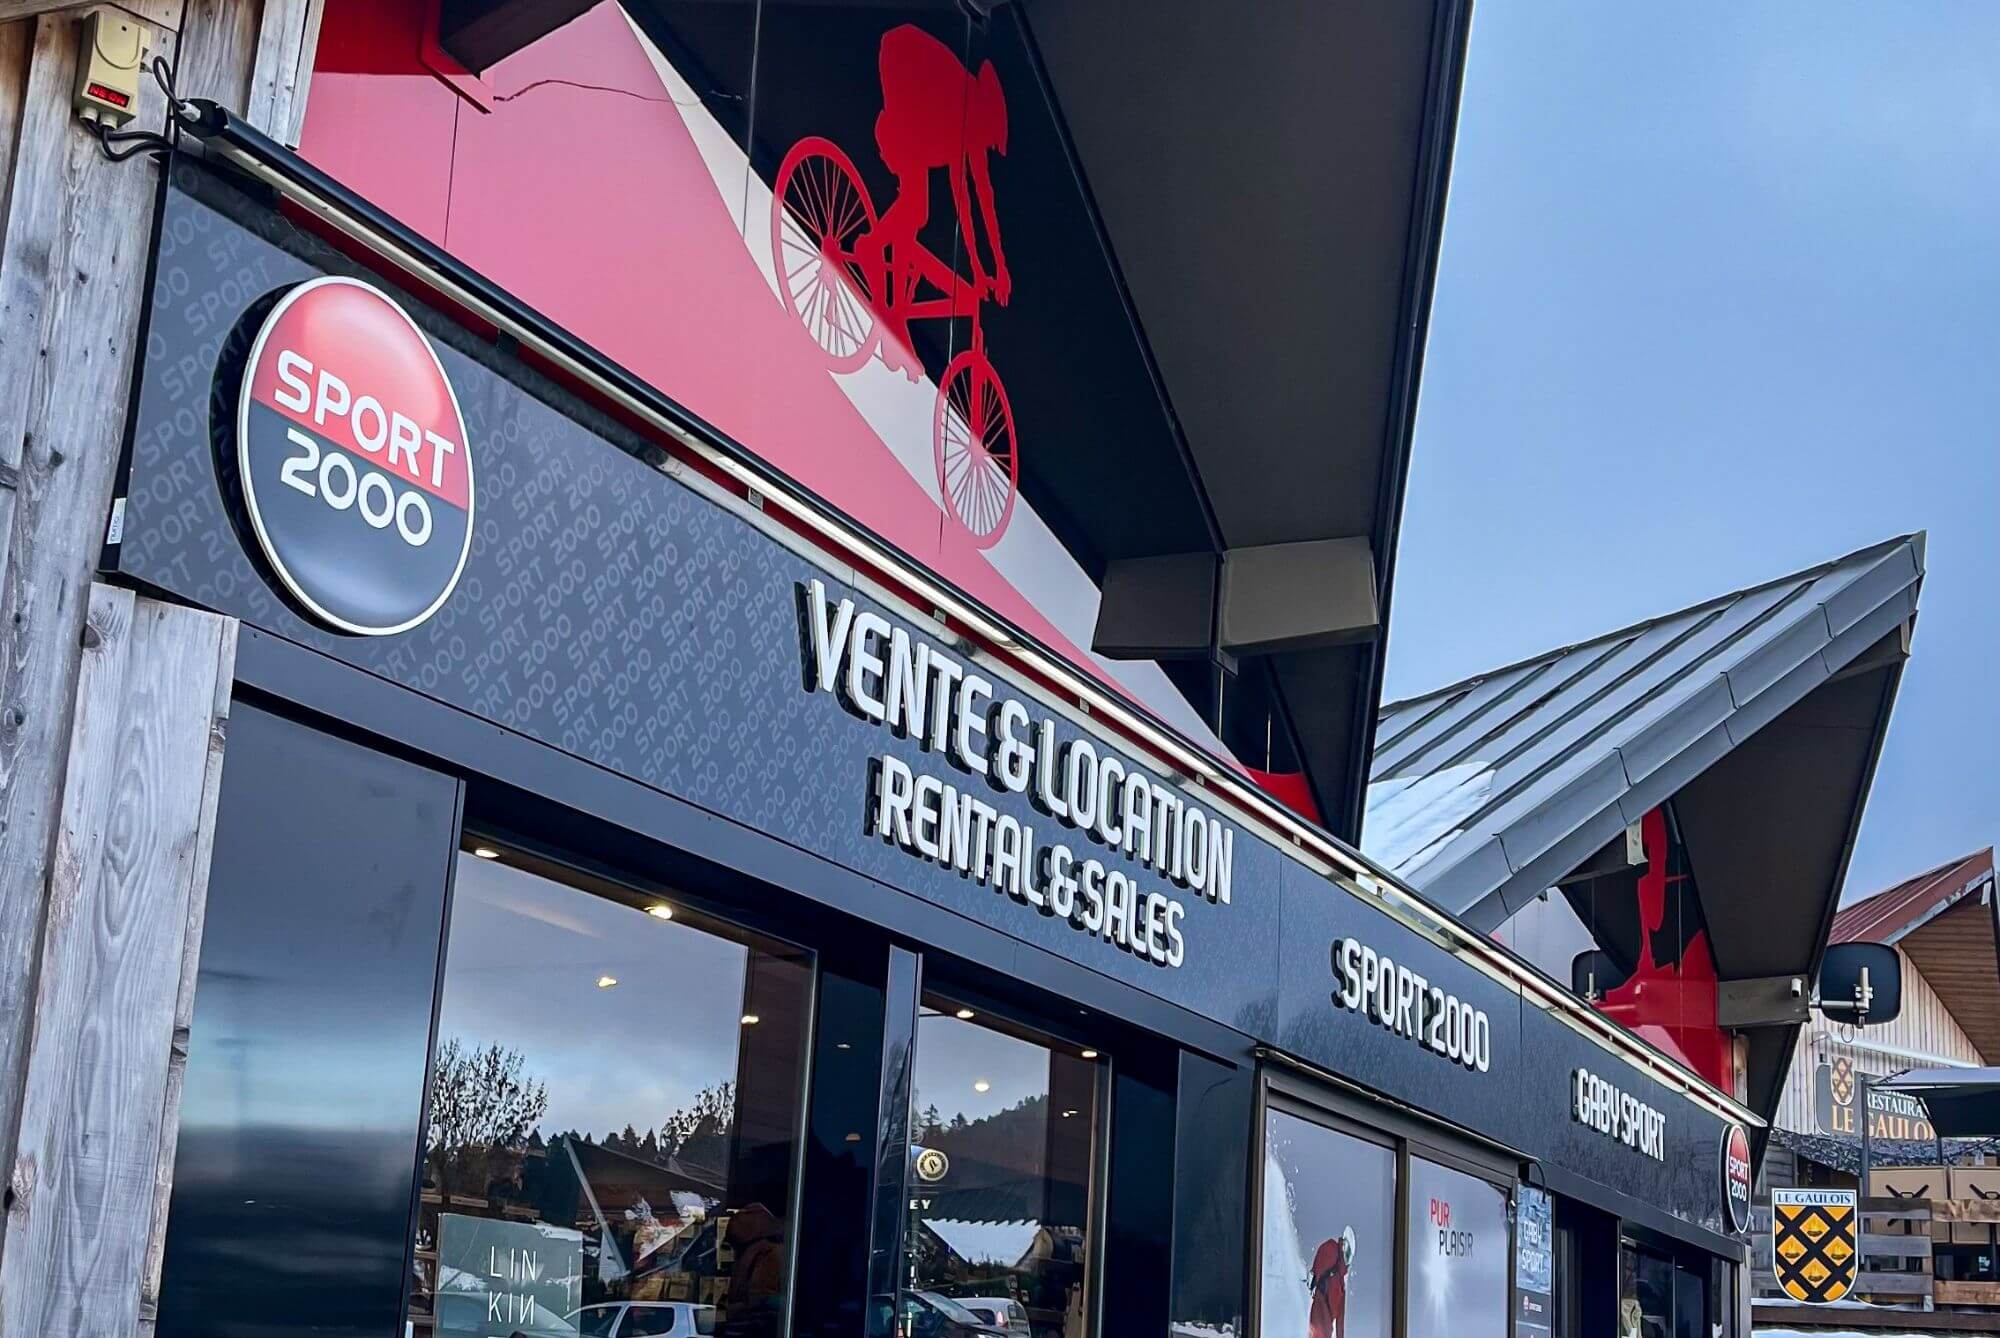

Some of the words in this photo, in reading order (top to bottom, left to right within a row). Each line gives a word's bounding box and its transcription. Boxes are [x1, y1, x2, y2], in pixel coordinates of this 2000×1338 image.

[274, 350, 455, 488] SPORT
[280, 427, 433, 546] 2000
[511, 447, 576, 519] SPORT
[564, 452, 615, 512] 2000
[495, 500, 559, 577] SPORT
[549, 503, 601, 566] 2000
[596, 487, 655, 560] SPORT
[644, 491, 691, 551] 2000
[480, 555, 543, 635] SPORT
[533, 559, 586, 622] 2000
[582, 539, 640, 615] SPORT
[631, 541, 678, 602] 2000
[674, 524, 727, 595] SPORT
[567, 593, 627, 670] SPORT
[617, 594, 665, 657] 2000
[660, 575, 714, 648] SPORT
[706, 578, 748, 636] 2000
[461, 613, 528, 694] SPORT
[518, 612, 571, 680] 2000
[603, 648, 652, 711] 2000
[648, 625, 701, 700] SPORT
[693, 627, 736, 685] 2000
[740, 637, 786, 706] SPORT
[552, 647, 611, 727] SPORT
[635, 679, 689, 755] SPORT
[700, 658, 742, 717] 2000
[642, 709, 696, 784] SPORT
[687, 708, 731, 771] 2000
[727, 687, 776, 759] SPORT
[809, 578, 993, 776] VENTE
[996, 699, 1036, 794] &
[1041, 718, 1234, 905] LOCATION
[716, 737, 766, 810] SPORT
[758, 735, 796, 795] 2000
[782, 761, 827, 833] SPORT
[878, 754, 1046, 907] RENTAL
[1049, 844, 1079, 919] &
[1081, 859, 1186, 969] SALES
[1340, 937, 1428, 1044] SPORT
[1430, 986, 1490, 1073] 2000
[1577, 1068, 1621, 1140] GABY
[1620, 1092, 1667, 1163] SPORT
[1832, 1105, 1855, 1133] LE
[1729, 1155, 1749, 1181] SPORT
[1731, 1179, 1748, 1203] 2000
[1777, 1193, 1791, 1204] LE
[1795, 1192, 1852, 1205] GAULOIS
[1430, 1198, 1450, 1229] PUR
[1439, 1229, 1474, 1258] PLAISIR
[490, 1246, 537, 1281] LIN
